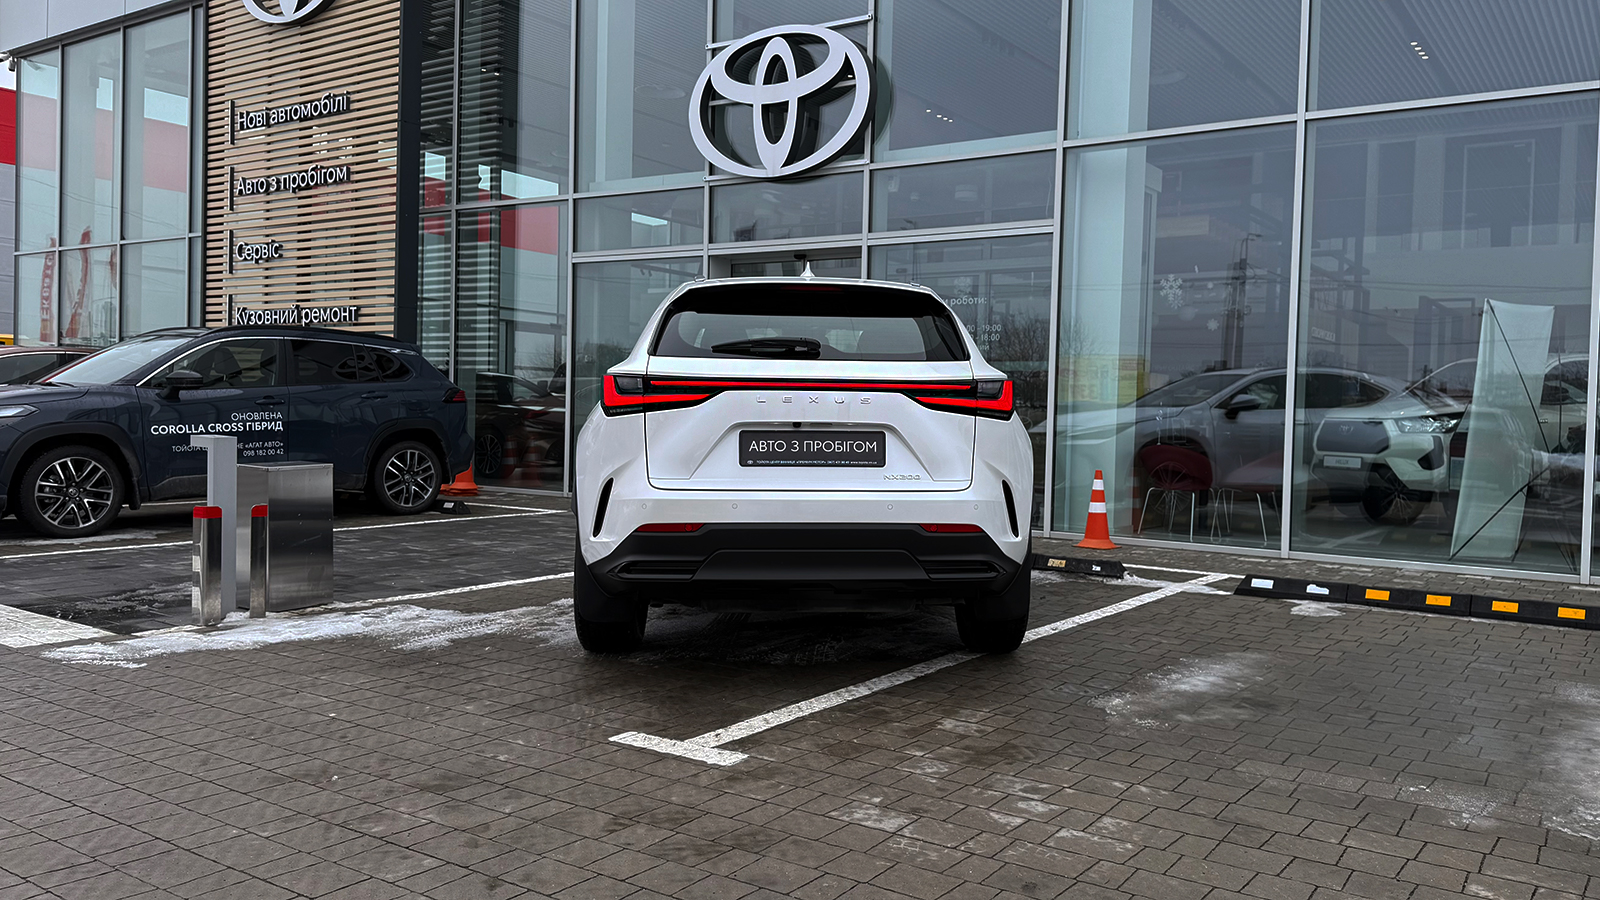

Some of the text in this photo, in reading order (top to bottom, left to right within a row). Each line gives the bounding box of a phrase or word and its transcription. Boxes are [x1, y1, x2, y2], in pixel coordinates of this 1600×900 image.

[237, 90, 348, 130] Нові автомобілі
[236, 164, 348, 195] Авто з пробігом
[235, 239, 280, 263] Сервіс
[950, 295, 988, 307] роботи:
[235, 304, 358, 327] Кузовний ремонт
[982, 324, 1002, 332] 19:00
[981, 333, 1000, 341] 18:00
[231, 411, 283, 421] ОНОВЛЕНА
[150, 421, 283, 435] COROLLA CROSS ГІБРИД
[748, 440, 877, 453] АВТО З ПРОБІГОМ
